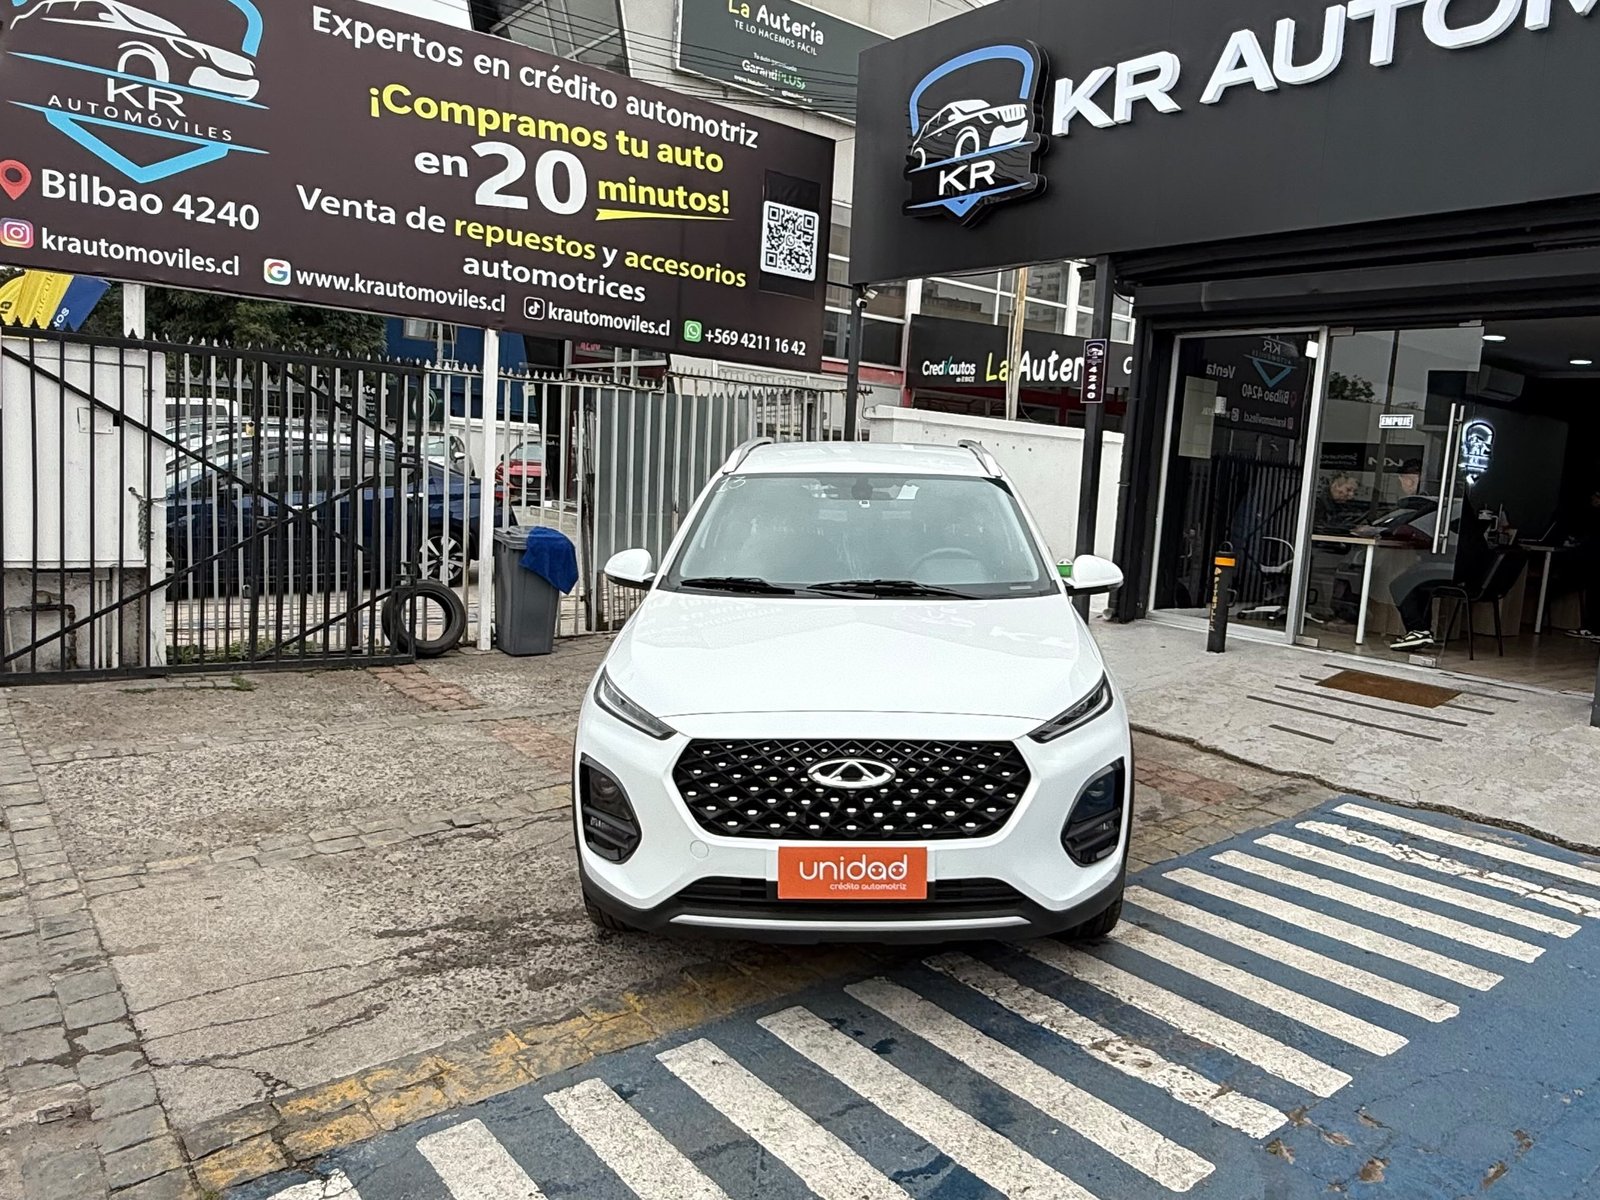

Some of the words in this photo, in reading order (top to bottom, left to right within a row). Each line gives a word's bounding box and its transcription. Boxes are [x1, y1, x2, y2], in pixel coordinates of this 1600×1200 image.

[729, 0, 750, 18] La
[734, 20, 744, 30] TE
[746, 24, 756, 34] LO
[758, 29, 795, 48] HACEMOS
[107, 78, 186, 117] KR
[312, 5, 464, 67] Expertos
[474, 54, 510, 80] en
[519, 65, 618, 109] crédito
[626, 95, 760, 149] automotriz
[1052, 51, 1182, 137] KR
[48, 95, 232, 141] AUTOMÓVILES
[369, 83, 607, 151] ¡Compramos
[616, 130, 649, 159] tu
[657, 142, 724, 173] auto
[42, 168, 163, 215] Bilbao
[173, 194, 259, 230] 4240
[414, 152, 469, 178] en
[471, 140, 588, 215] 20
[598, 177, 730, 215] minutos!
[939, 160, 996, 195] KR
[42, 227, 239, 276] krautomoviles.cl
[296, 184, 396, 225] Venta
[406, 206, 446, 234] de
[454, 217, 596, 260] repuestos
[602, 247, 618, 268] y
[625, 249, 747, 288] accesorios
[296, 269, 505, 313] www.krautomoviles.cl
[463, 256, 646, 302] automotrices
[548, 302, 670, 337] krautomoviles.cl
[705, 329, 739, 346] +569
[740, 333, 770, 351] 4211
[775, 337, 789, 353] 16
[790, 339, 806, 356] 42
[986, 352, 1008, 382] La
[800, 854, 907, 880] unidad
